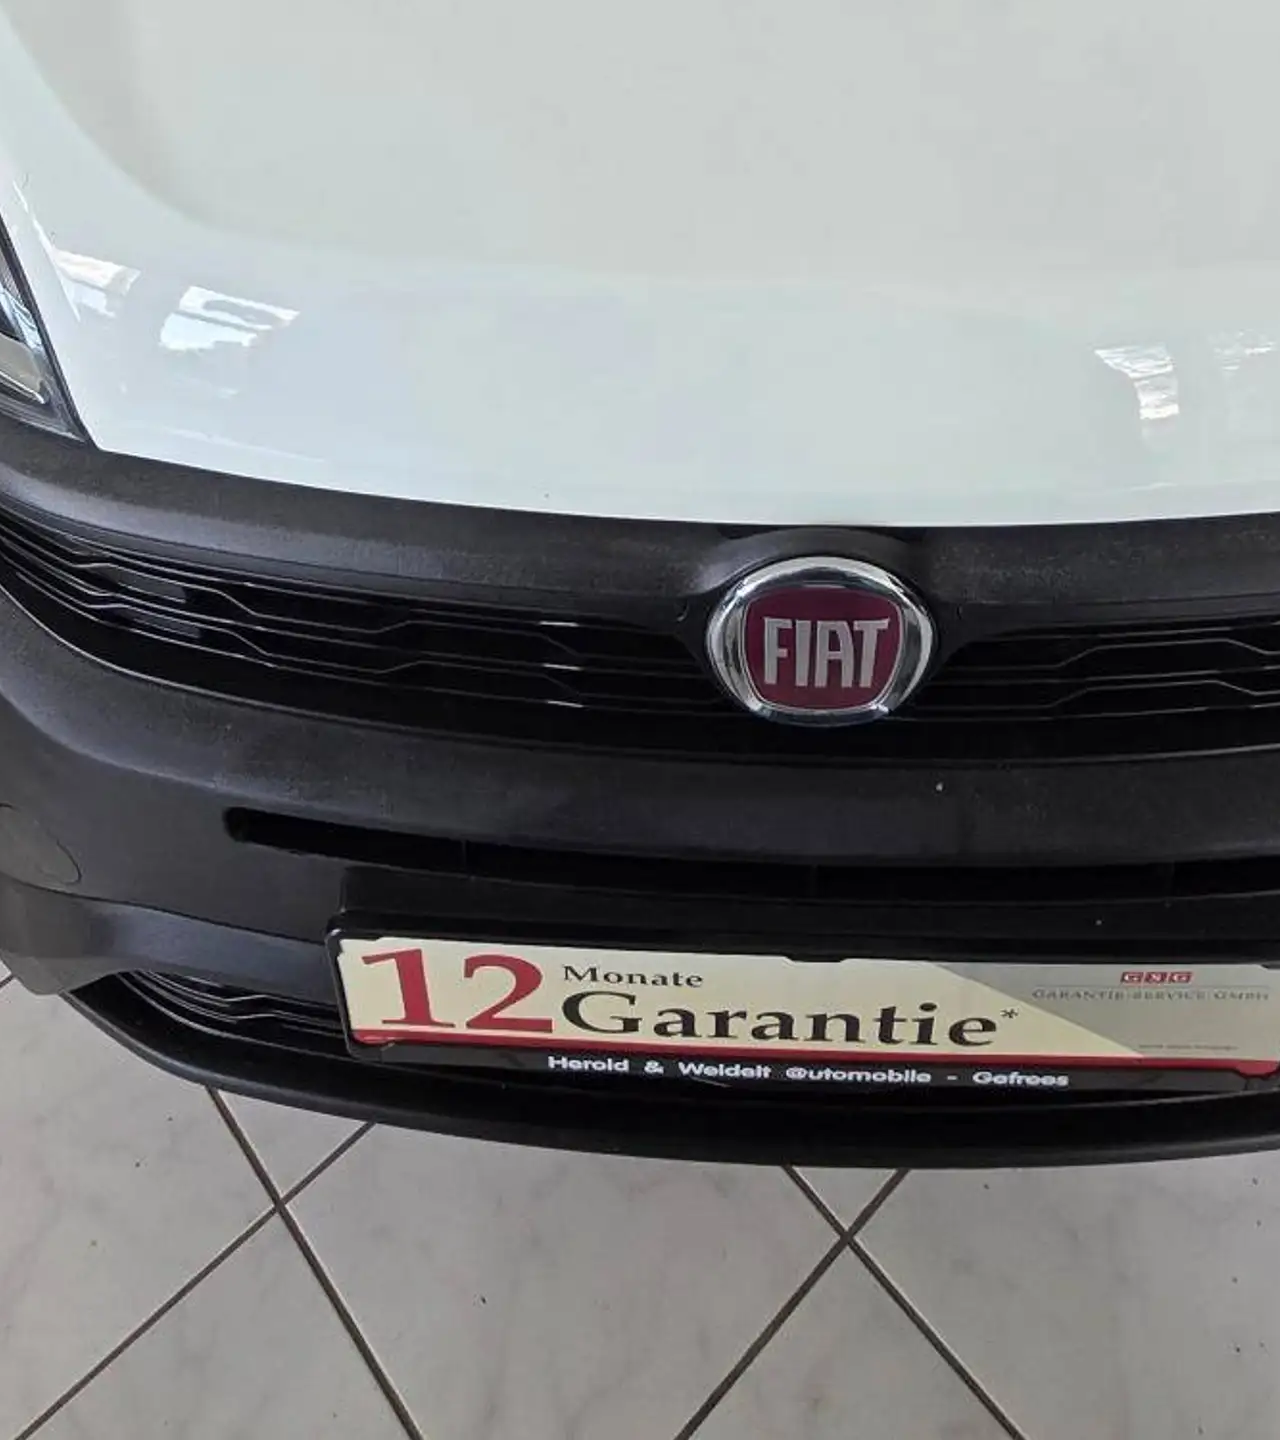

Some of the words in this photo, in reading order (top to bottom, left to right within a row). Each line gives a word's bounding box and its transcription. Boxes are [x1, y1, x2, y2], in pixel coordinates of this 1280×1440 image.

[763, 616, 890, 689] FIAT
[362, 947, 554, 1035] 12
[563, 964, 704, 989] Monate
[548, 1056, 630, 1073] Herold
[644, 1060, 665, 1075] &
[972, 1070, 1070, 1087] Gefrees
